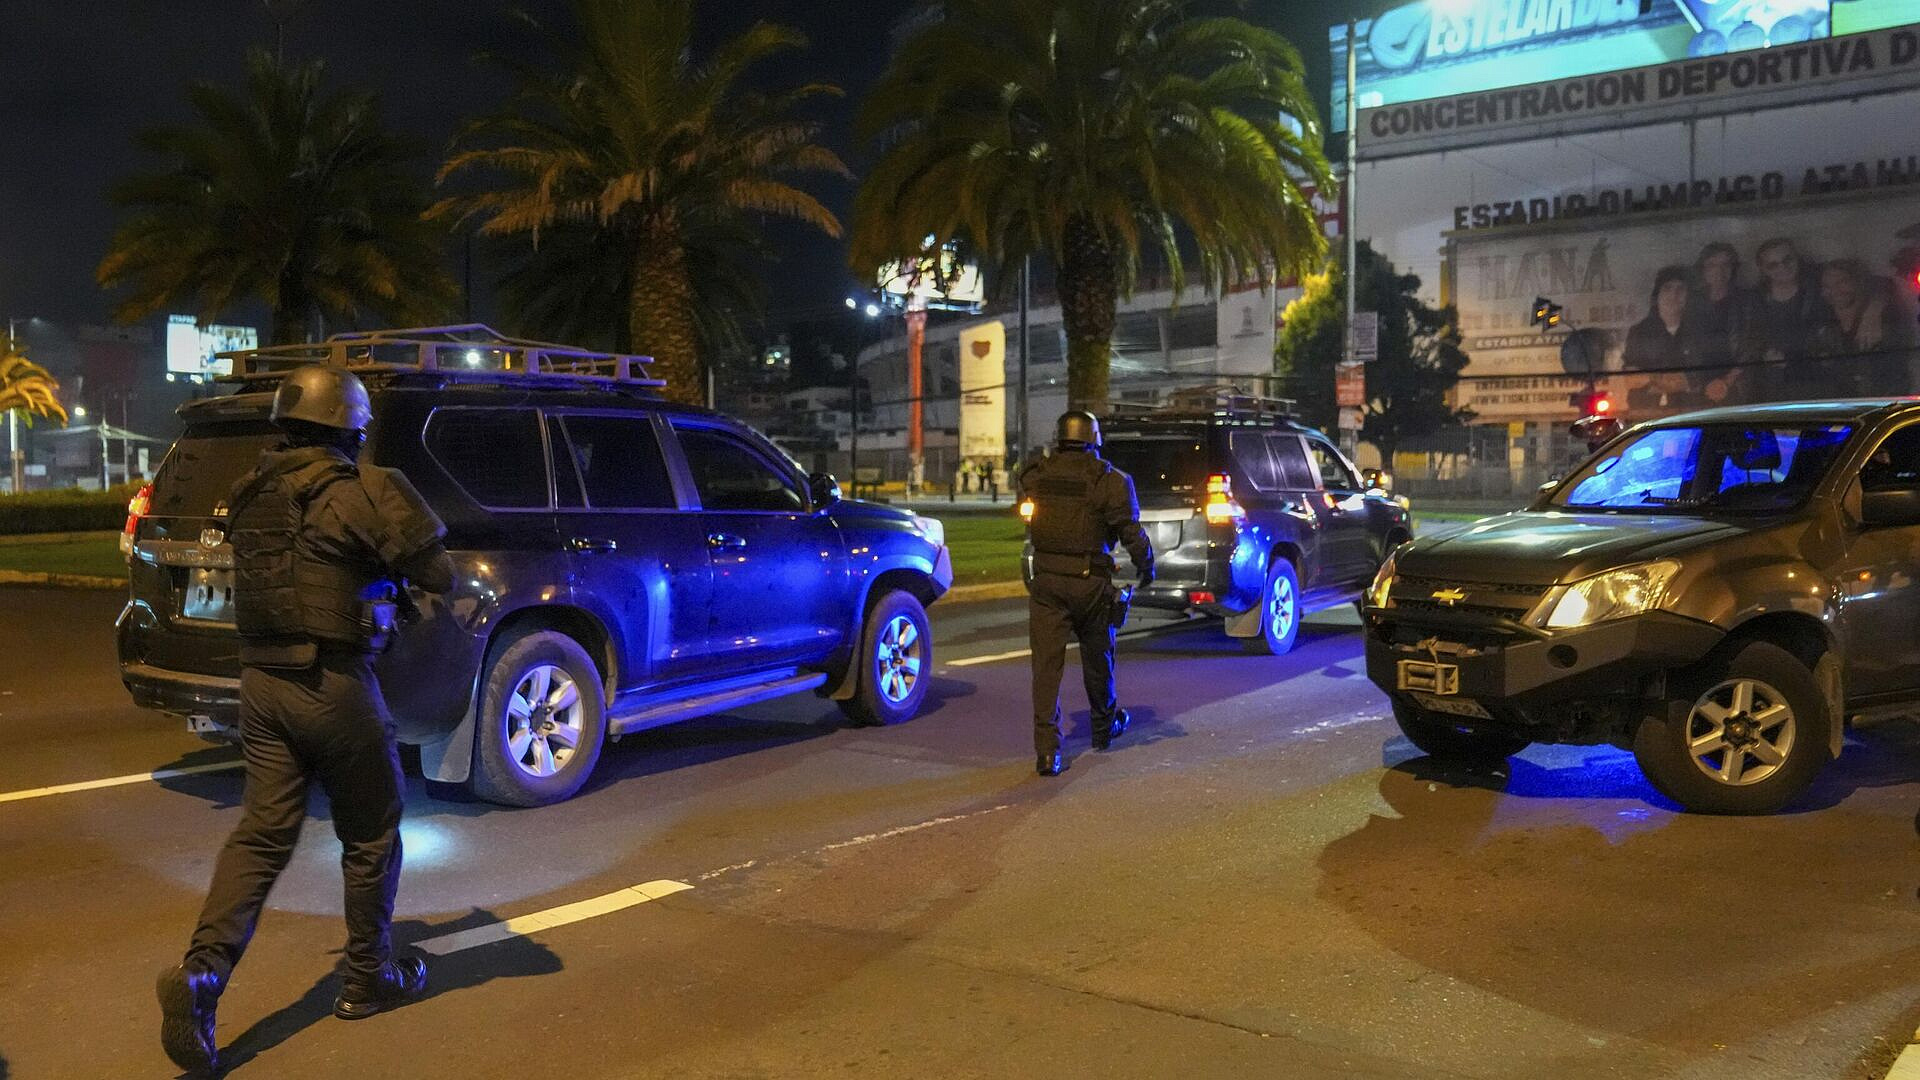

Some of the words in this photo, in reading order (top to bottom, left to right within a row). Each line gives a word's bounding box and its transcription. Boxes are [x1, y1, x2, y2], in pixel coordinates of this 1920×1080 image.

[1370, 72, 1645, 138] CONCENTRACION
[1658, 37, 1875, 98] DEPORTIVA
[1453, 194, 1585, 231] ESTADIO
